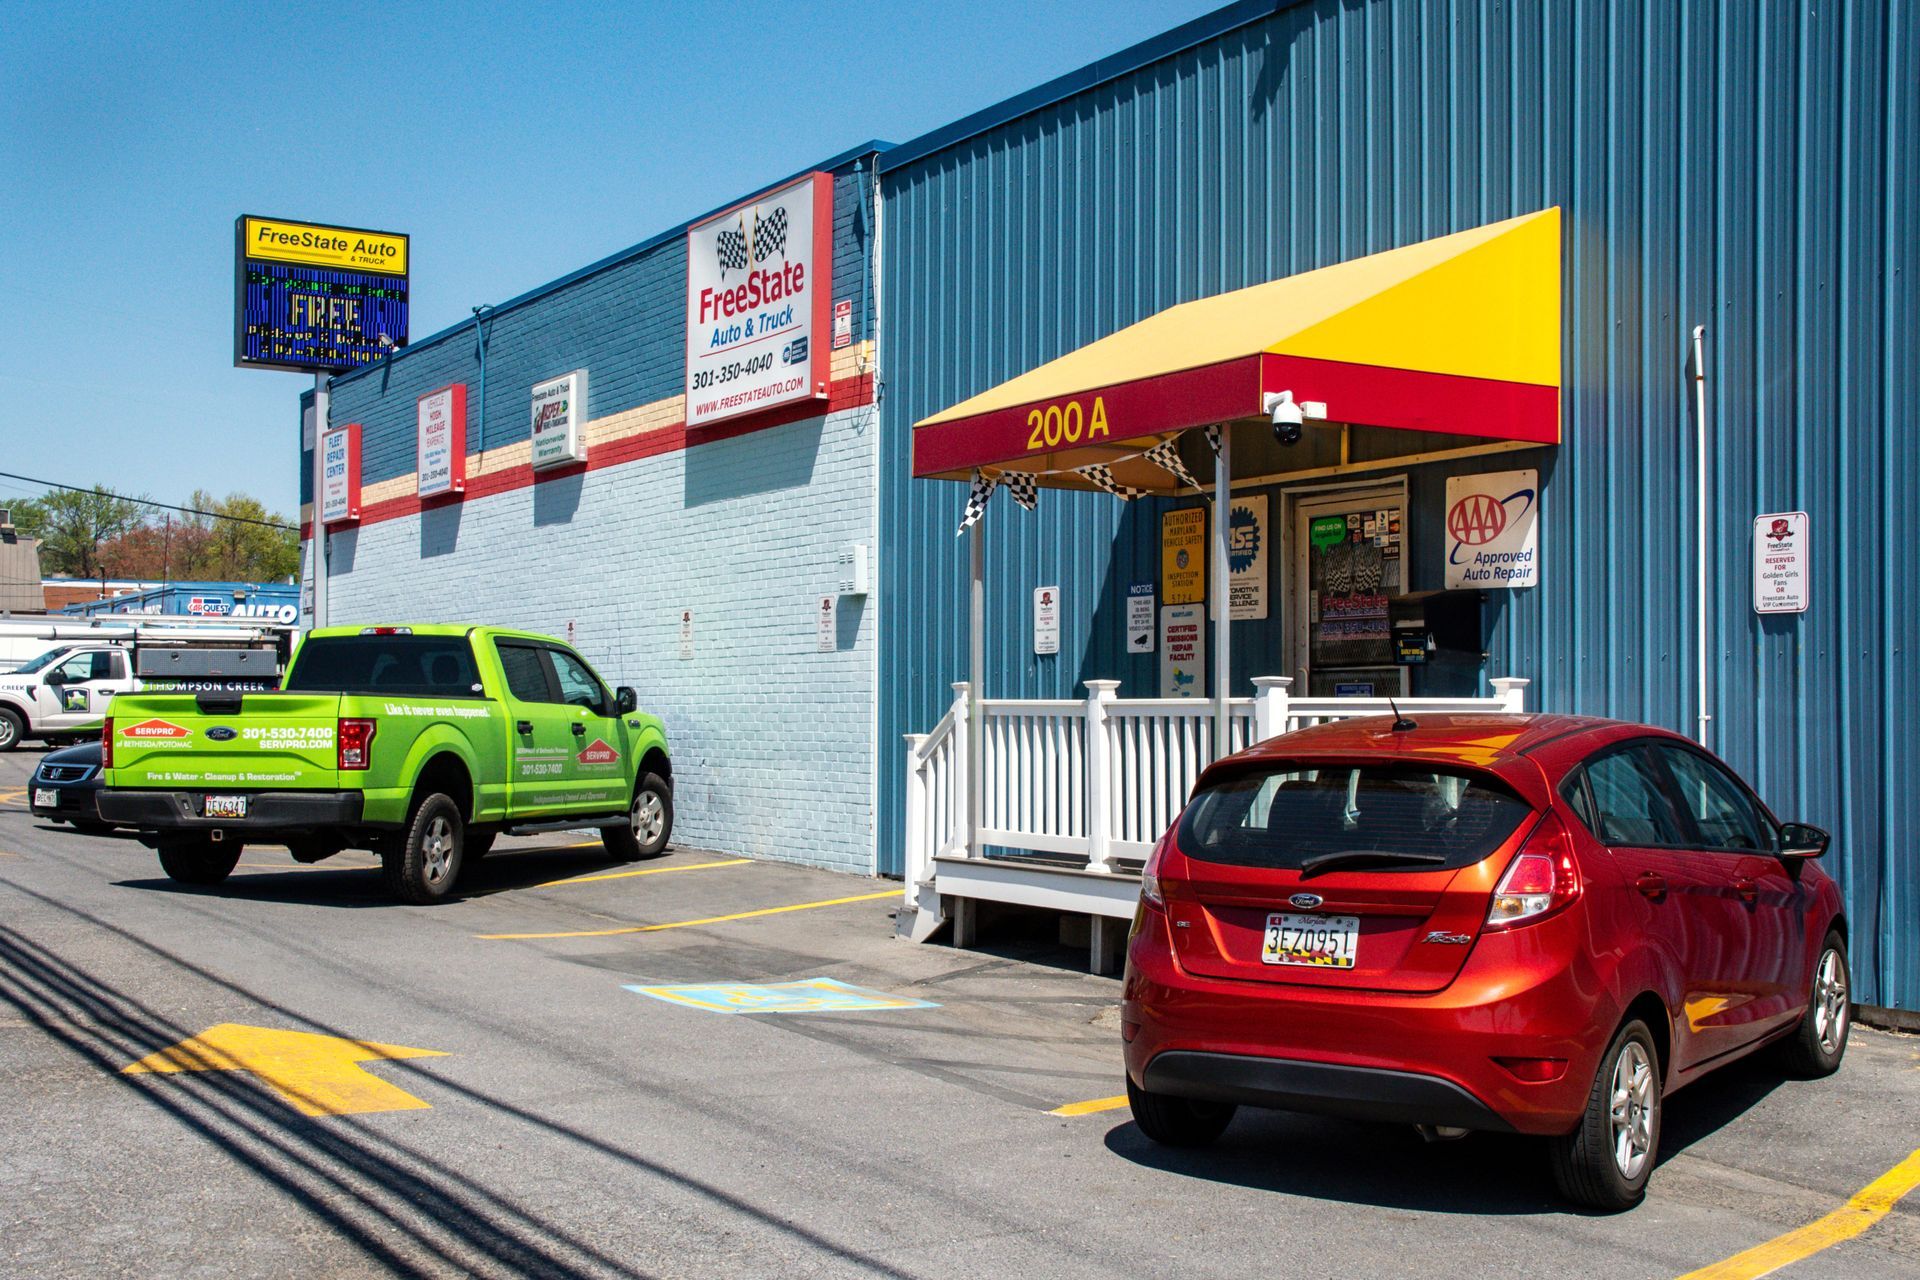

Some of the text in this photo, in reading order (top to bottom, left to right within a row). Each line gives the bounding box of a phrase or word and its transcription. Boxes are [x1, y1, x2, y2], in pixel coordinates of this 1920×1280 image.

[258, 227, 397, 257] FreeState Auto
[359, 256, 385, 265] TRUCK
[699, 260, 804, 324] FreeState
[292, 293, 361, 332] FREE
[711, 304, 794, 348] Auto & Truck
[692, 352, 773, 390] 301-350-4040
[696, 376, 804, 416] WWW.FREESTATEAUTO.COM
[426, 421, 445, 435] MILEAGE
[1027, 396, 1110, 450] 200 A
[329, 434, 343, 448] FLEET
[327, 448, 344, 463] REPAIR
[327, 463, 344, 478] CENTER
[1164, 512, 1203, 526] AUTHORIZED
[1455, 496, 1500, 543] AAA
[1169, 525, 1196, 536] MARYLAND
[1164, 535, 1203, 547] VEHICLE SAFETY
[1474, 548, 1533, 567] Approved
[1765, 556, 1795, 564] RESERVED
[1168, 571, 1199, 580] INSPECTION
[1463, 565, 1532, 582] Auto Repair
[1762, 570, 1799, 579] Golden Girls
[1130, 584, 1153, 594] NOTICE
[231, 604, 298, 624] AUTO
[1168, 625, 1197, 633] CERTIFIED
[1167, 634, 1198, 643] EMISSIONS
[1170, 653, 1195, 661] FACILITY
[149, 682, 265, 691] THOMPSON CREEK
[385, 703, 404, 716] Like
[403, 704, 412, 716] it
[412, 706, 434, 716] never
[435, 707, 454, 716] even
[243, 728, 332, 739] 301-530-7400
[124, 740, 192, 748] BETHESDA/POTOMAC
[260, 740, 333, 749] SERVPRO.COM
[586, 751, 610, 760] SERVPRO
[522, 764, 563, 775] 301-530-7400
[147, 772, 163, 780] Fire
[165, 772, 171, 780] &
[172, 772, 198, 780] Water
[204, 772, 236, 782] Cleanup
[1295, 896, 1315, 905] Ford
[1298, 916, 1327, 926] Maryland
[1268, 927, 1349, 955] 3EZ0951
[1421, 931, 1471, 944] Fiesta
